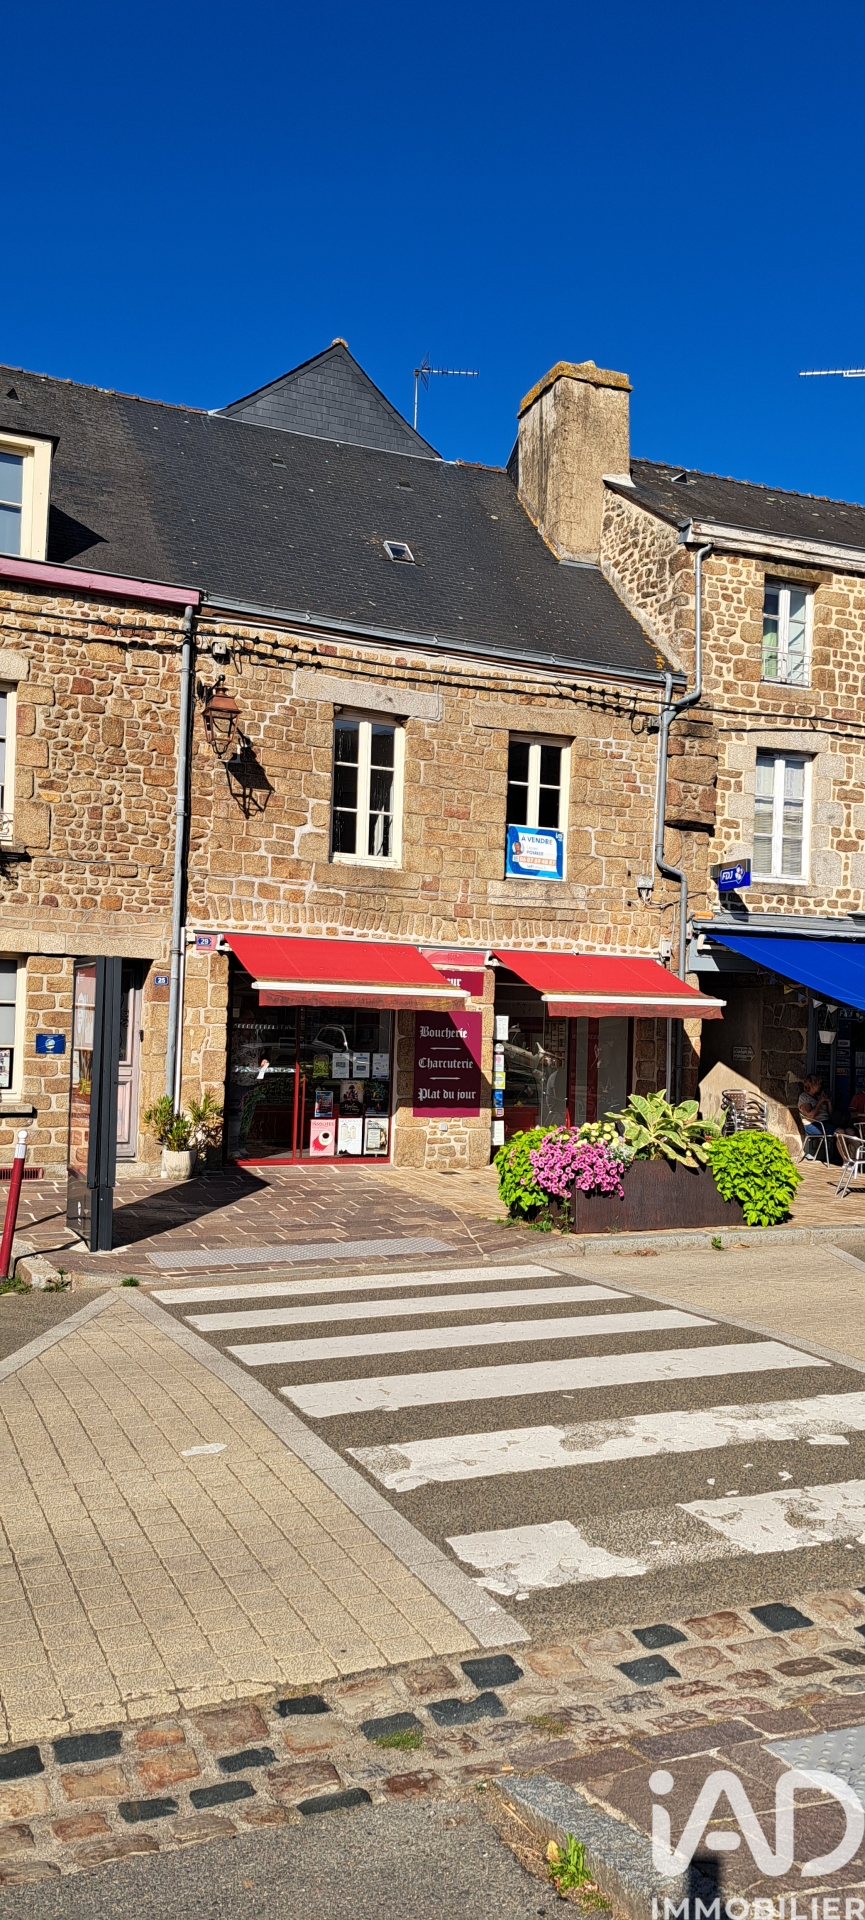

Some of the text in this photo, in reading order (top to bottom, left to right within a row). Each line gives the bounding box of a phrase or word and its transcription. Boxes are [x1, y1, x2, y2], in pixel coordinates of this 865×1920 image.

[527, 836, 553, 845] VENDRE
[721, 871, 733, 881] FDJ
[419, 1025, 468, 1039] Boucherie
[418, 1057, 474, 1070] Charcuterie
[417, 1087, 477, 1102] Plat du jour
